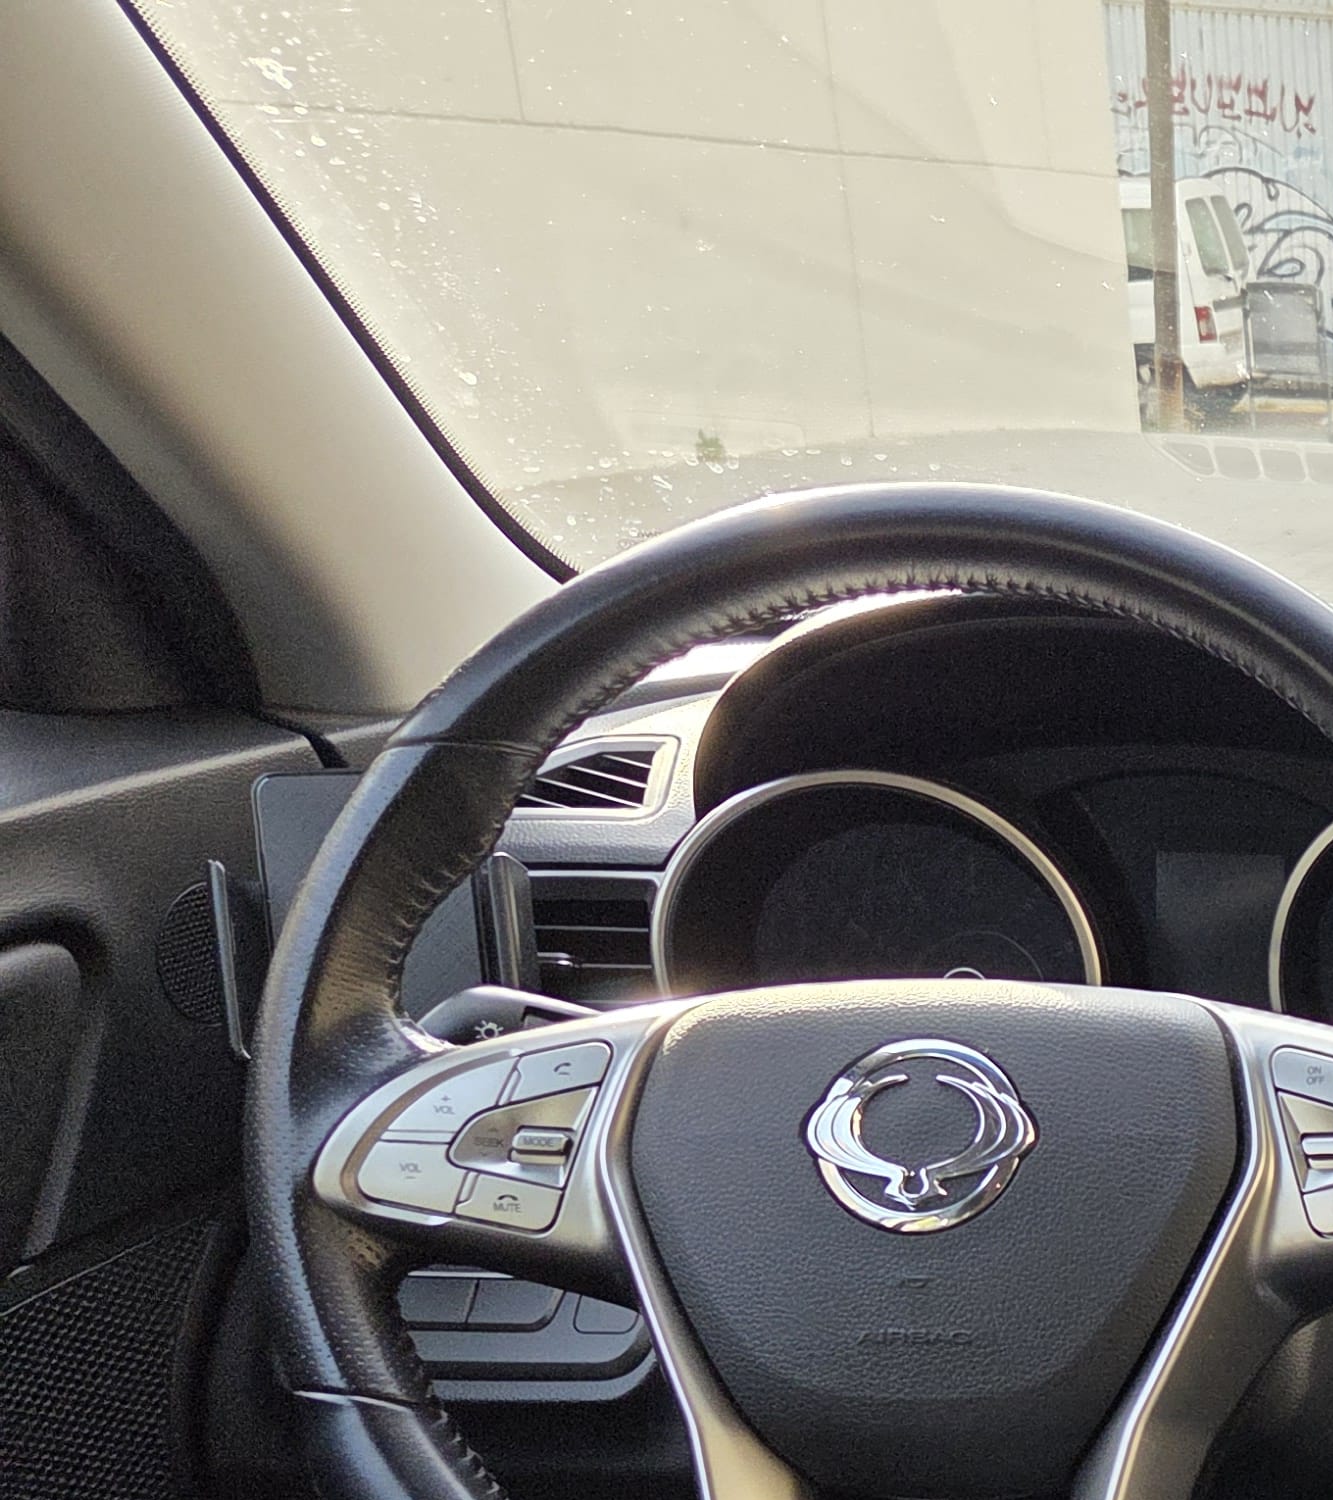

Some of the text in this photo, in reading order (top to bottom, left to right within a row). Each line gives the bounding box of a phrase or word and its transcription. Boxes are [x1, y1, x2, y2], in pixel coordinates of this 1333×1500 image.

[1306, 1066, 1322, 1075] ON
[1305, 1076, 1324, 1085] OFF
[432, 1104, 455, 1115] VOL
[474, 1136, 505, 1148] SEEK
[523, 1137, 554, 1147] MODE
[400, 1162, 421, 1173] VOL
[493, 1202, 522, 1213] MUTE
